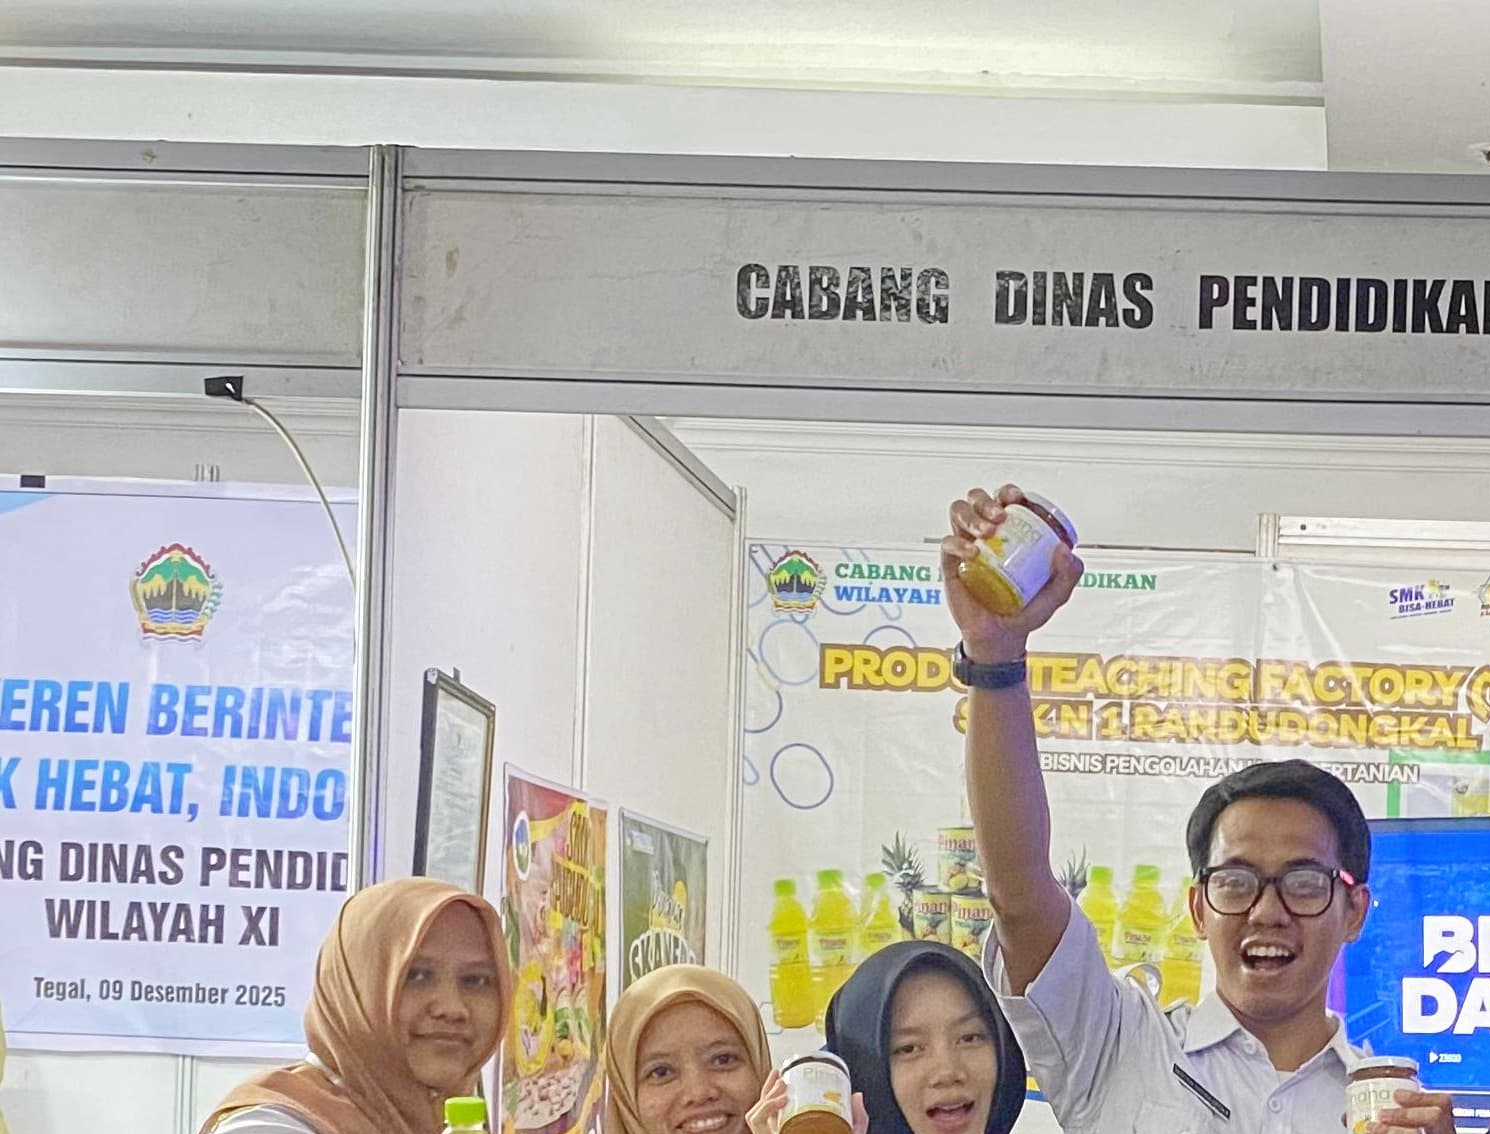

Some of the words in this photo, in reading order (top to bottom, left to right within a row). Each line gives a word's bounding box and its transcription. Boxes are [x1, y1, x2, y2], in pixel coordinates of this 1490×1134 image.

[735, 263, 950, 325] CABANG
[994, 269, 1154, 329] DINAS
[834, 562, 932, 582] CABANG
[1078, 572, 1157, 591] DIKAN
[833, 585, 941, 606] WILAYAH
[1388, 584, 1426, 605] SMK
[1028, 656, 1252, 700] TEACHING
[1261, 662, 1467, 708] FACTORY
[0, 678, 129, 735] EREN
[146, 683, 353, 743] BERINTE
[1101, 702, 1126, 738] 1
[1132, 702, 1480, 748] RANDUDONGKAL
[1040, 752, 1102, 774] BISNIS
[34, 758, 200, 822] HEBAT,
[219, 765, 346, 821] INDO
[60, 842, 184, 886] DINAS
[45, 898, 225, 945] WILAYAH
[238, 904, 281, 947] XI
[33, 976, 91, 1002] Tegal,
[99, 979, 123, 1001] 09
[130, 980, 228, 1005] Desember
[235, 984, 286, 1007] 2025
